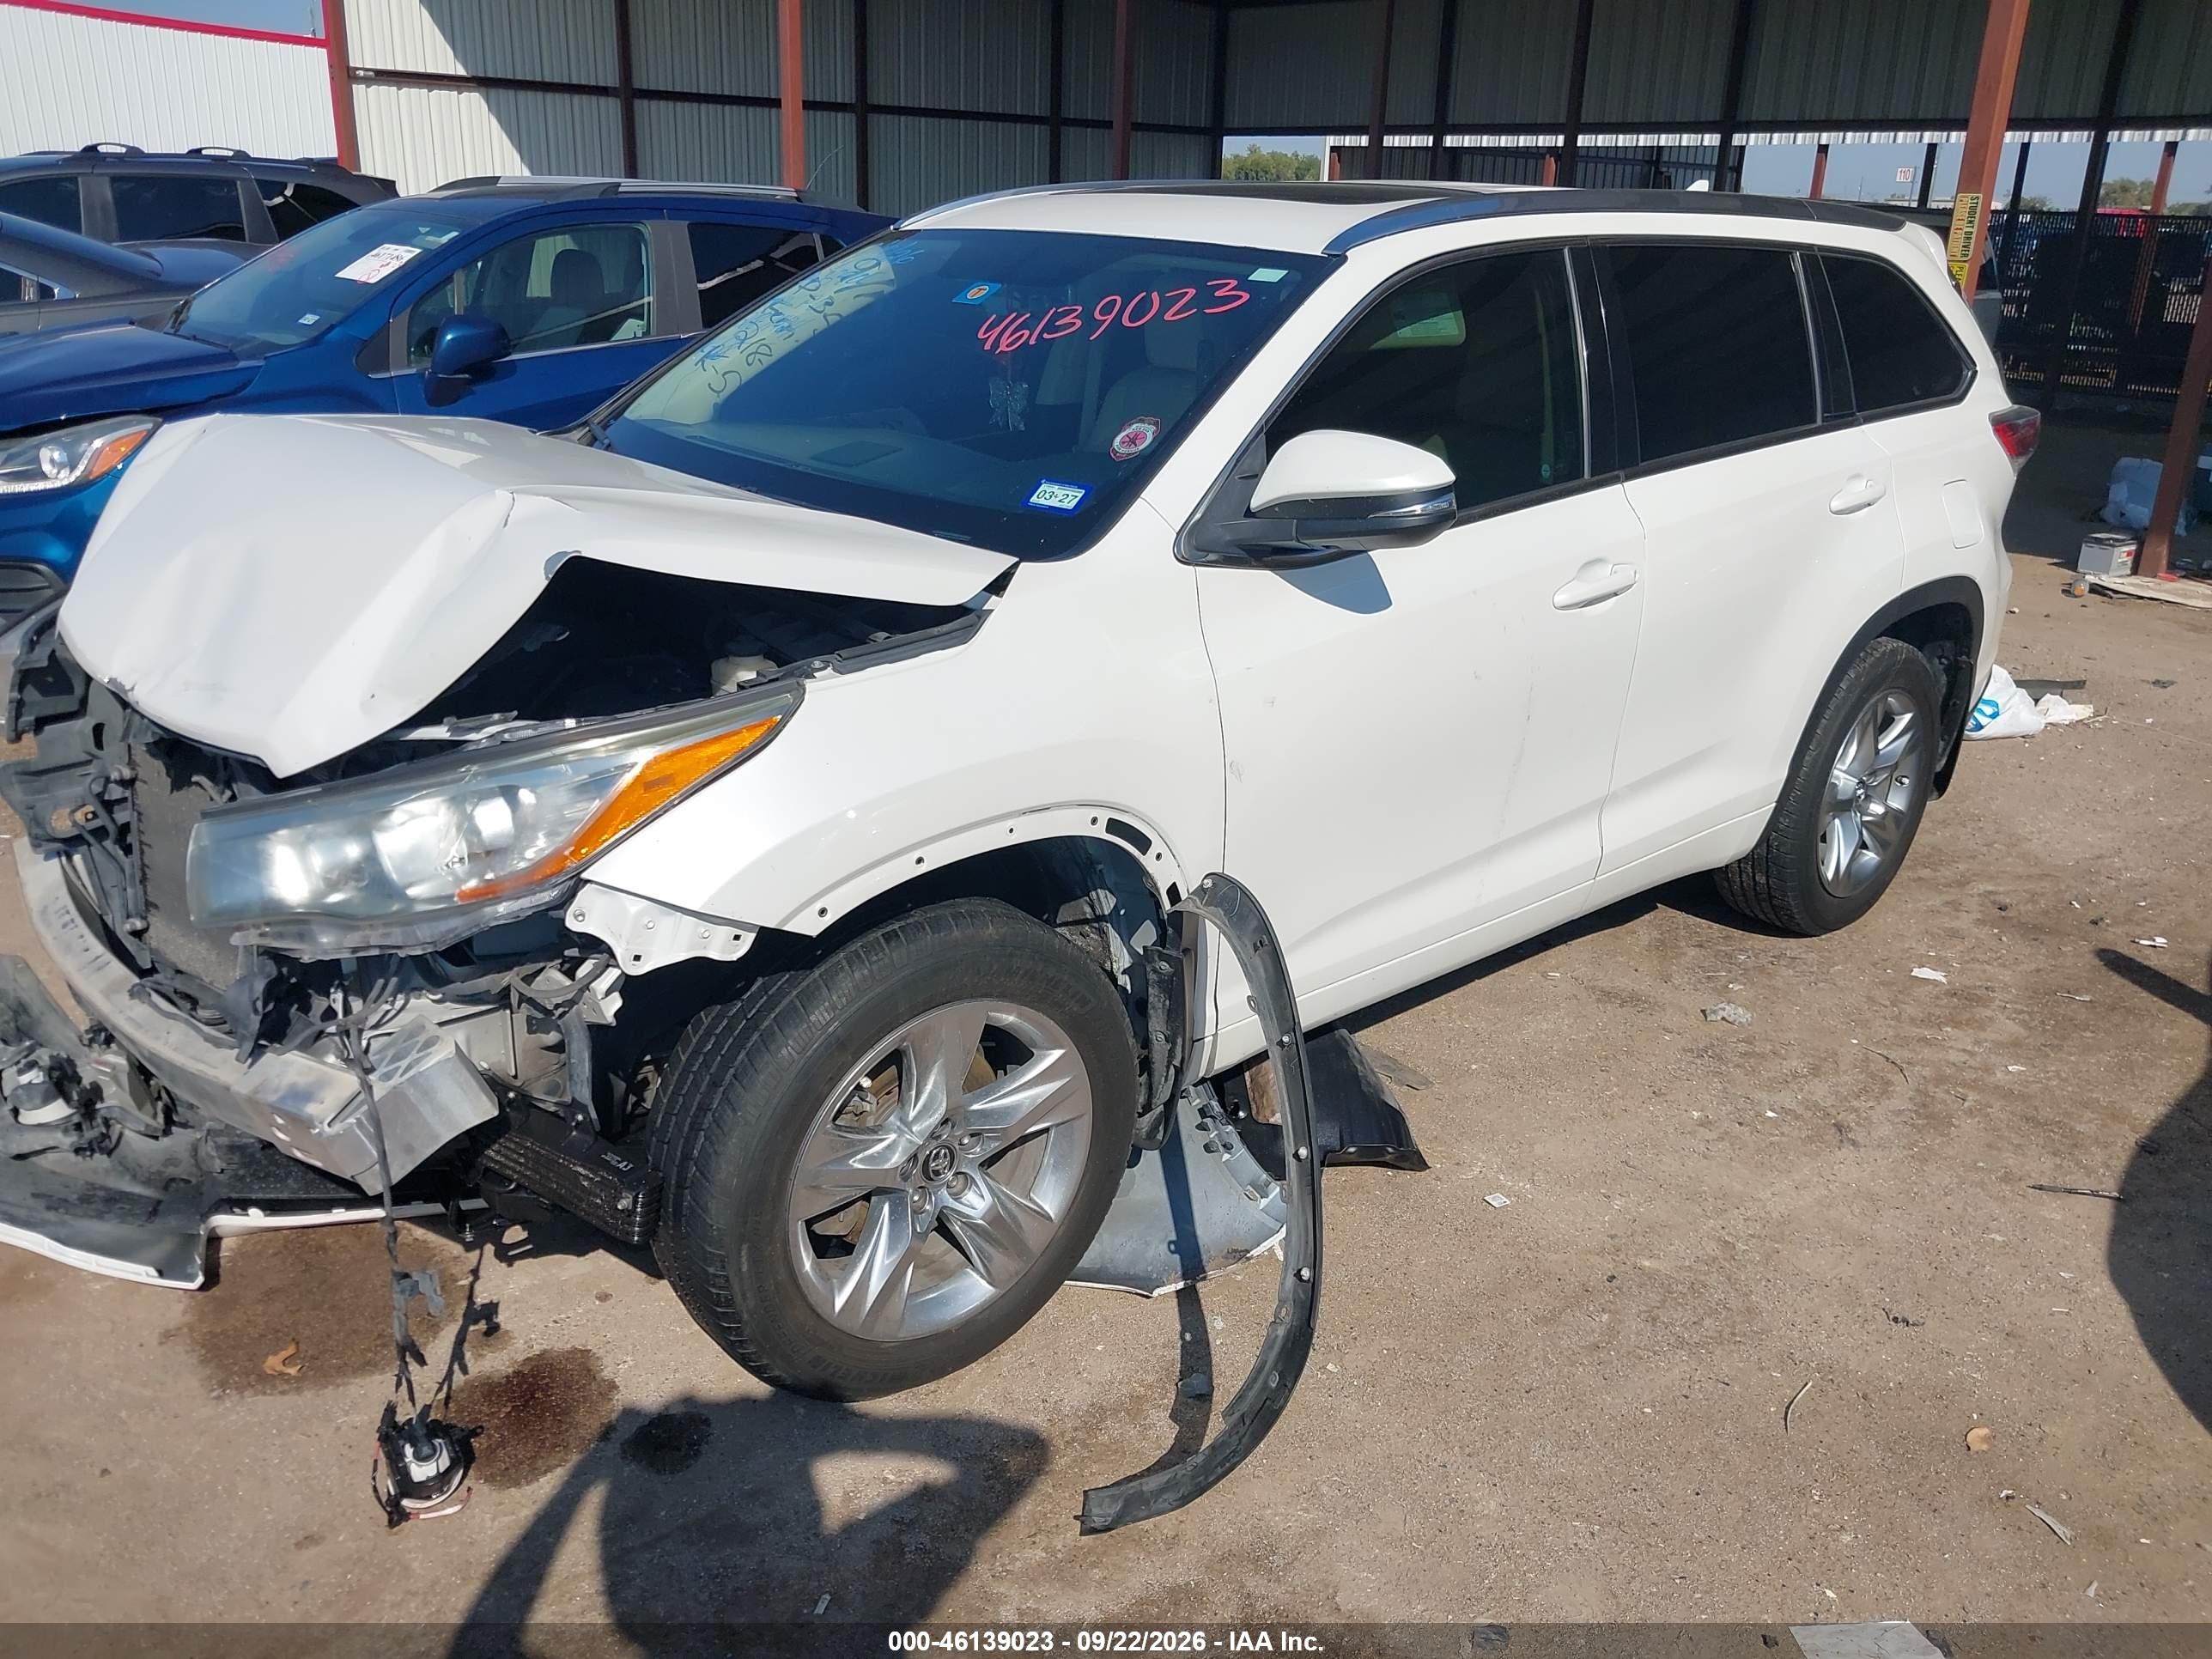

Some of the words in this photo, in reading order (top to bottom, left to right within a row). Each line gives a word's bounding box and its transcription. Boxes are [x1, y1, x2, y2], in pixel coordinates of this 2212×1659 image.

[1965, 196, 1980, 228] STUDENT
[1960, 231, 1973, 258] DRIVER
[977, 279, 1250, 355] 46139023
[1036, 489, 1054, 501] 03
[1058, 493, 1079, 505] 27
